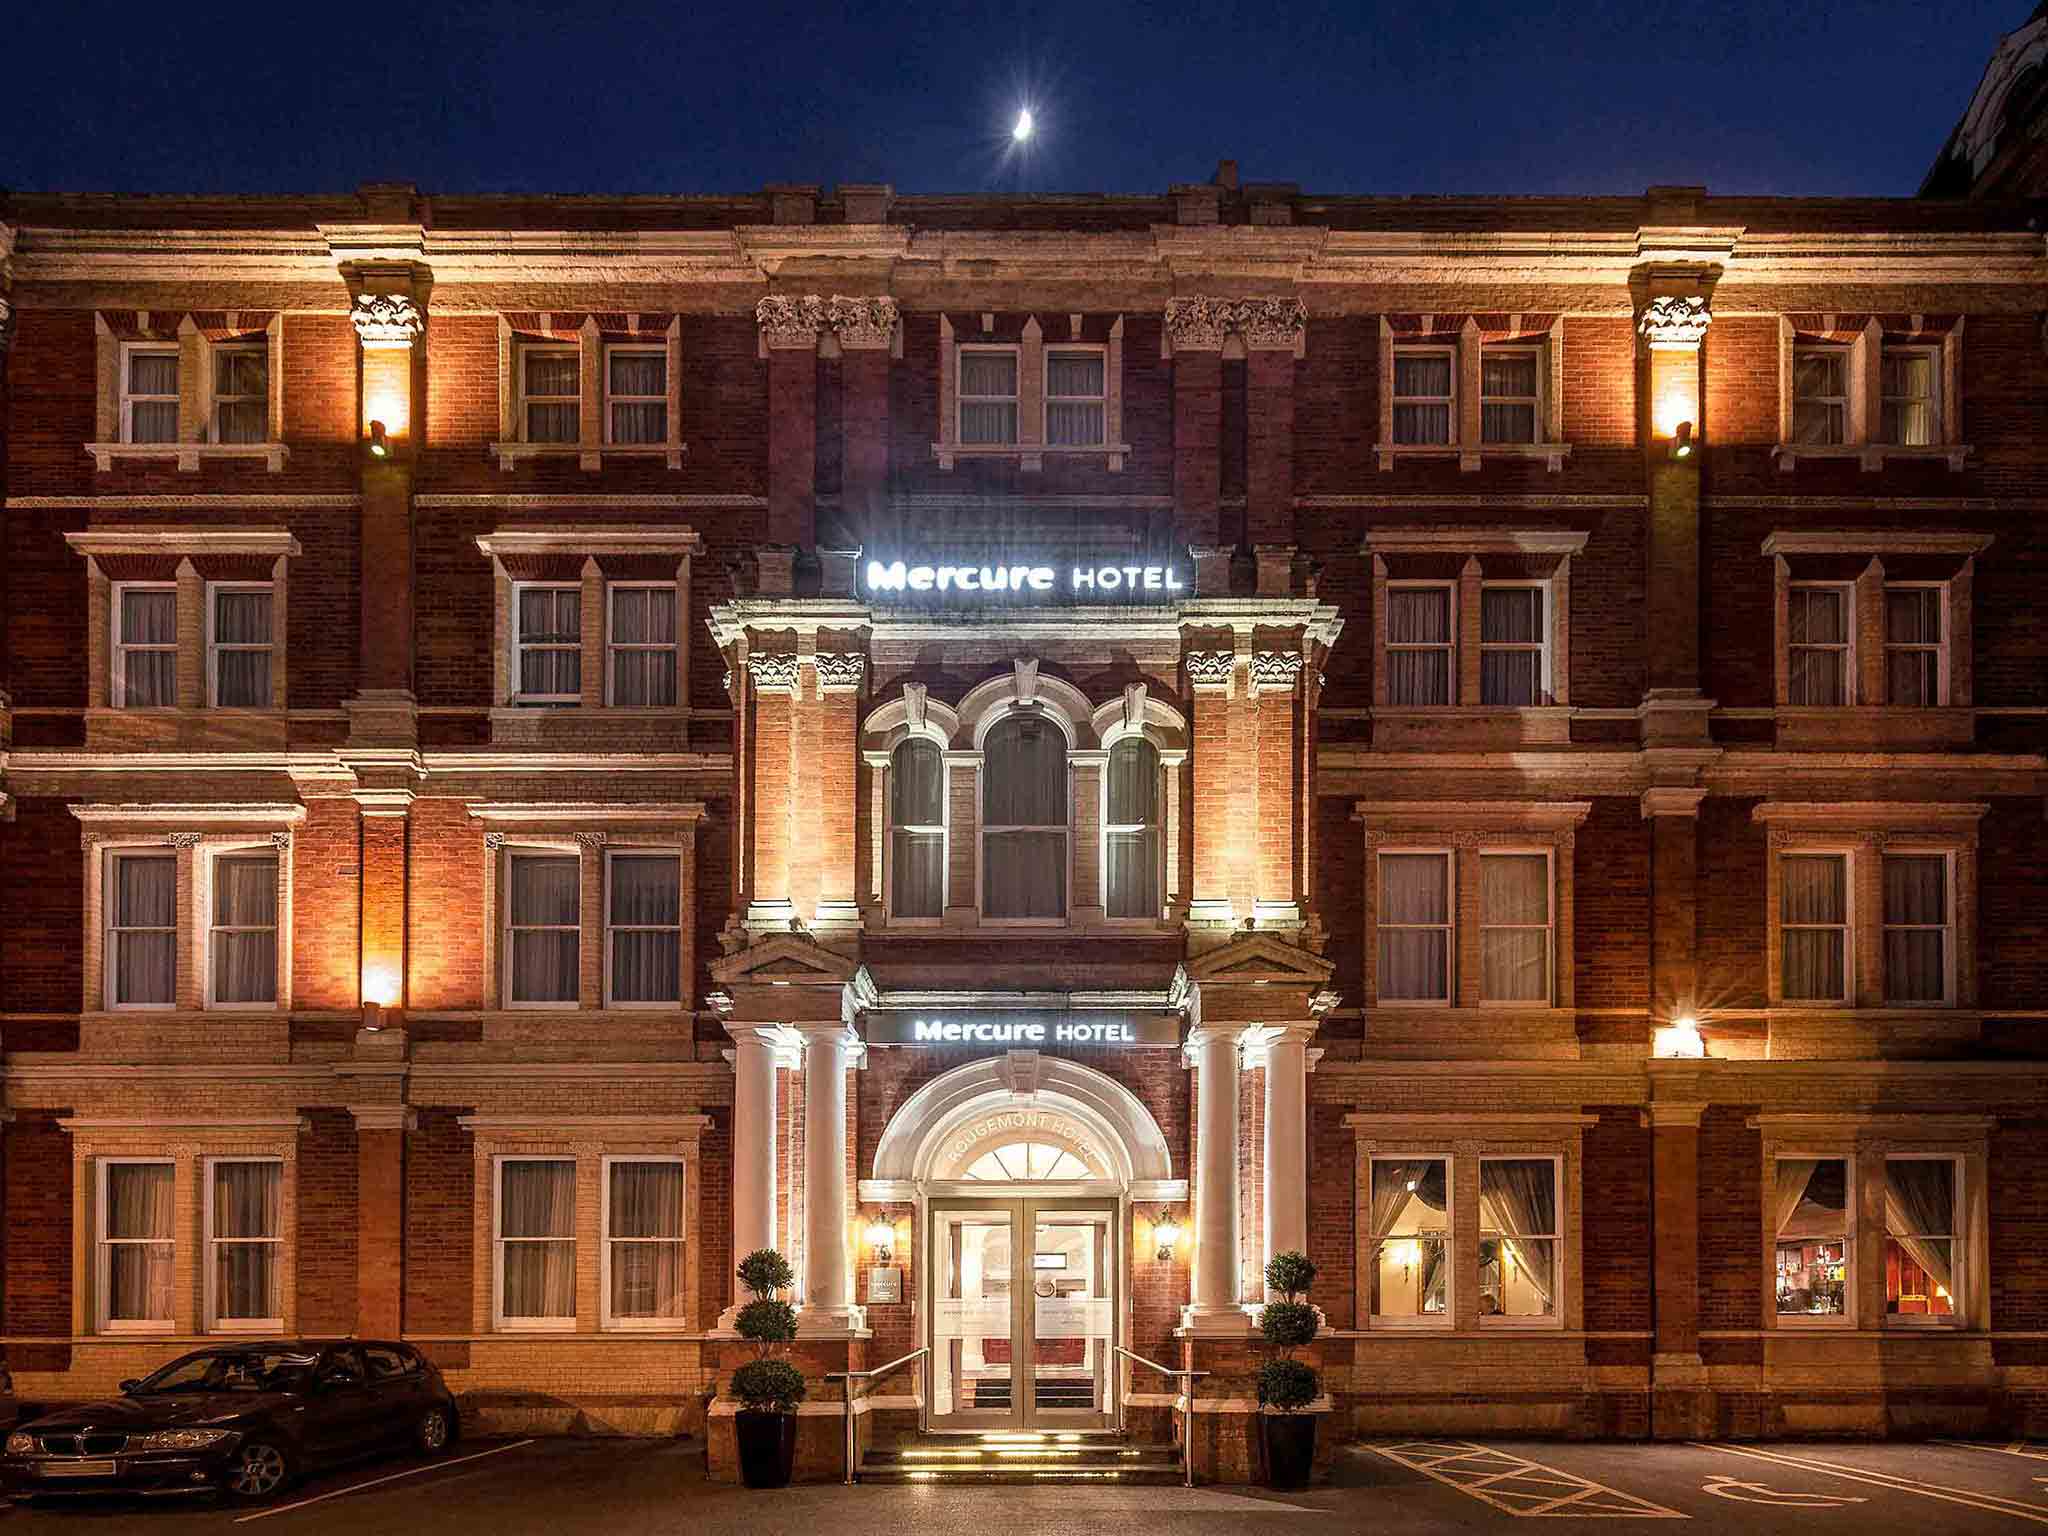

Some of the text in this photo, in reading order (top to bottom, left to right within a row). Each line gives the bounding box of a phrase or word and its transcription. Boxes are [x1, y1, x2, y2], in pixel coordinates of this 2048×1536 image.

[867, 561, 1183, 591] Mercure HOTEL
[914, 1020, 1135, 1041] Mercure HOTEL
[947, 1112, 1049, 1162] ROUGEMONT
